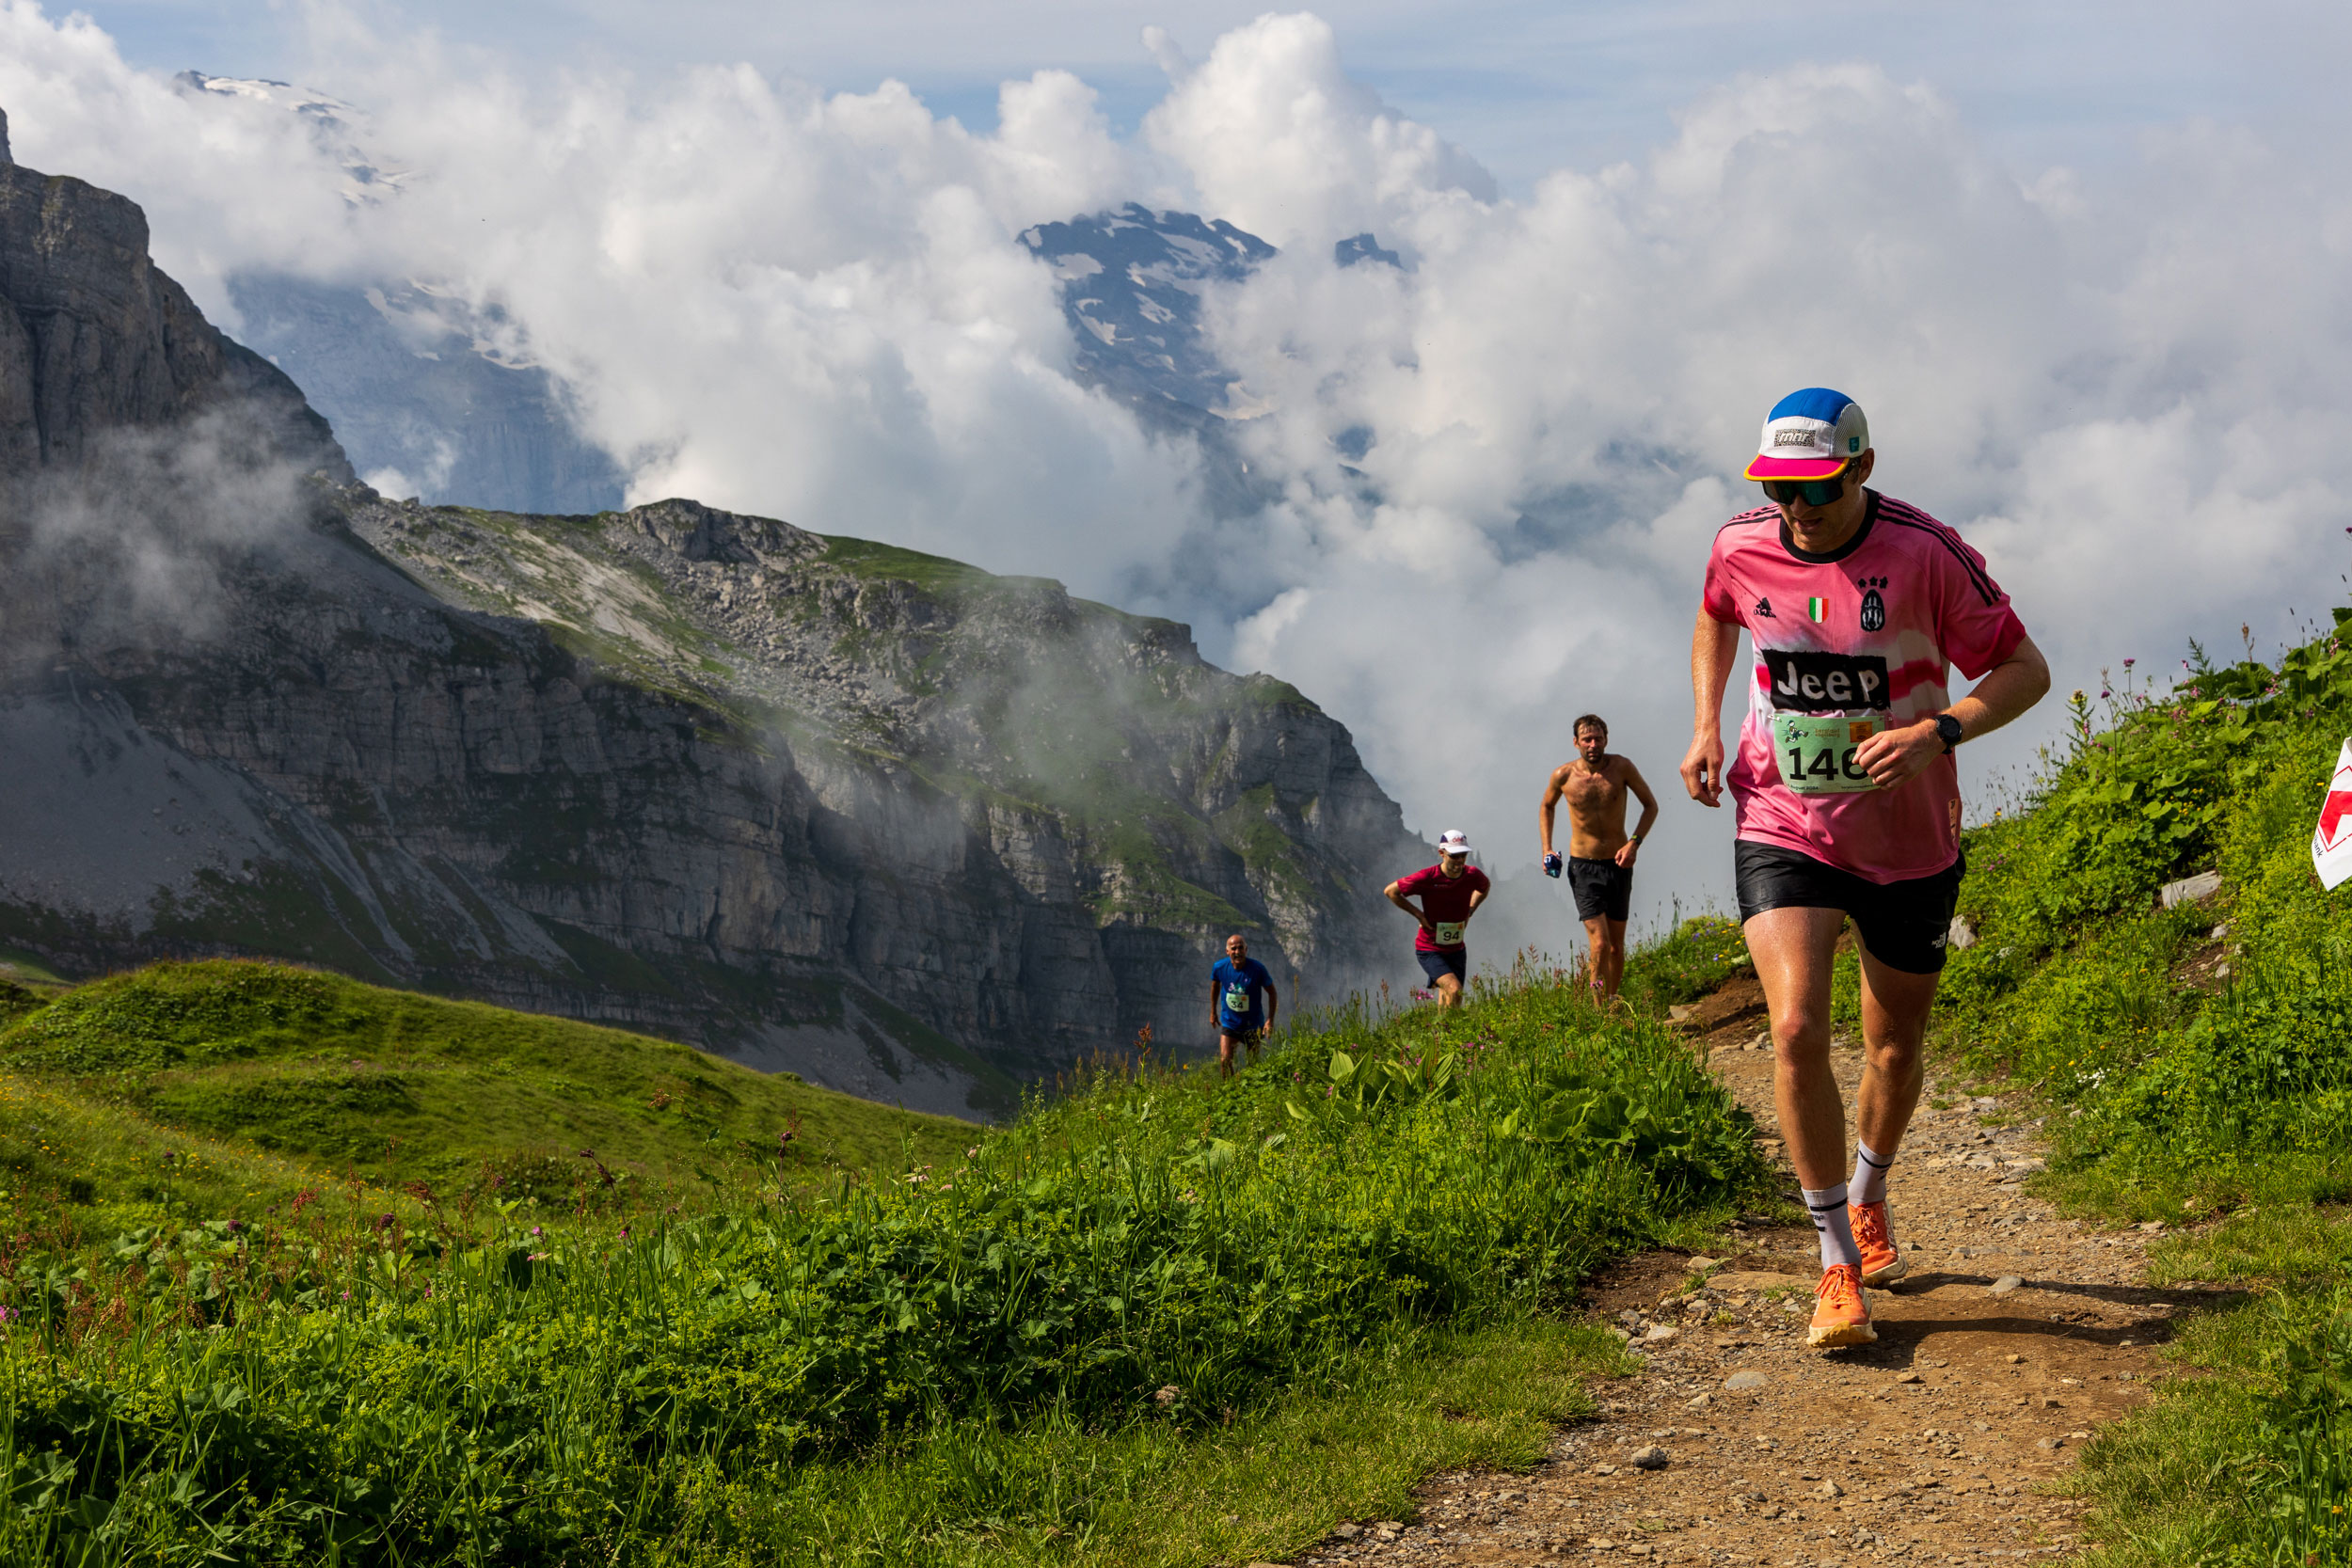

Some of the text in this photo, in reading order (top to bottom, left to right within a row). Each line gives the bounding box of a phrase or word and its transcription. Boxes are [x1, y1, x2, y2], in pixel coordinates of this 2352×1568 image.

[1777, 661, 1880, 703] Jeep
[1788, 747, 1869, 781] 146
[1443, 931, 1460, 942] 94
[1231, 1001, 1244, 1009] 34
